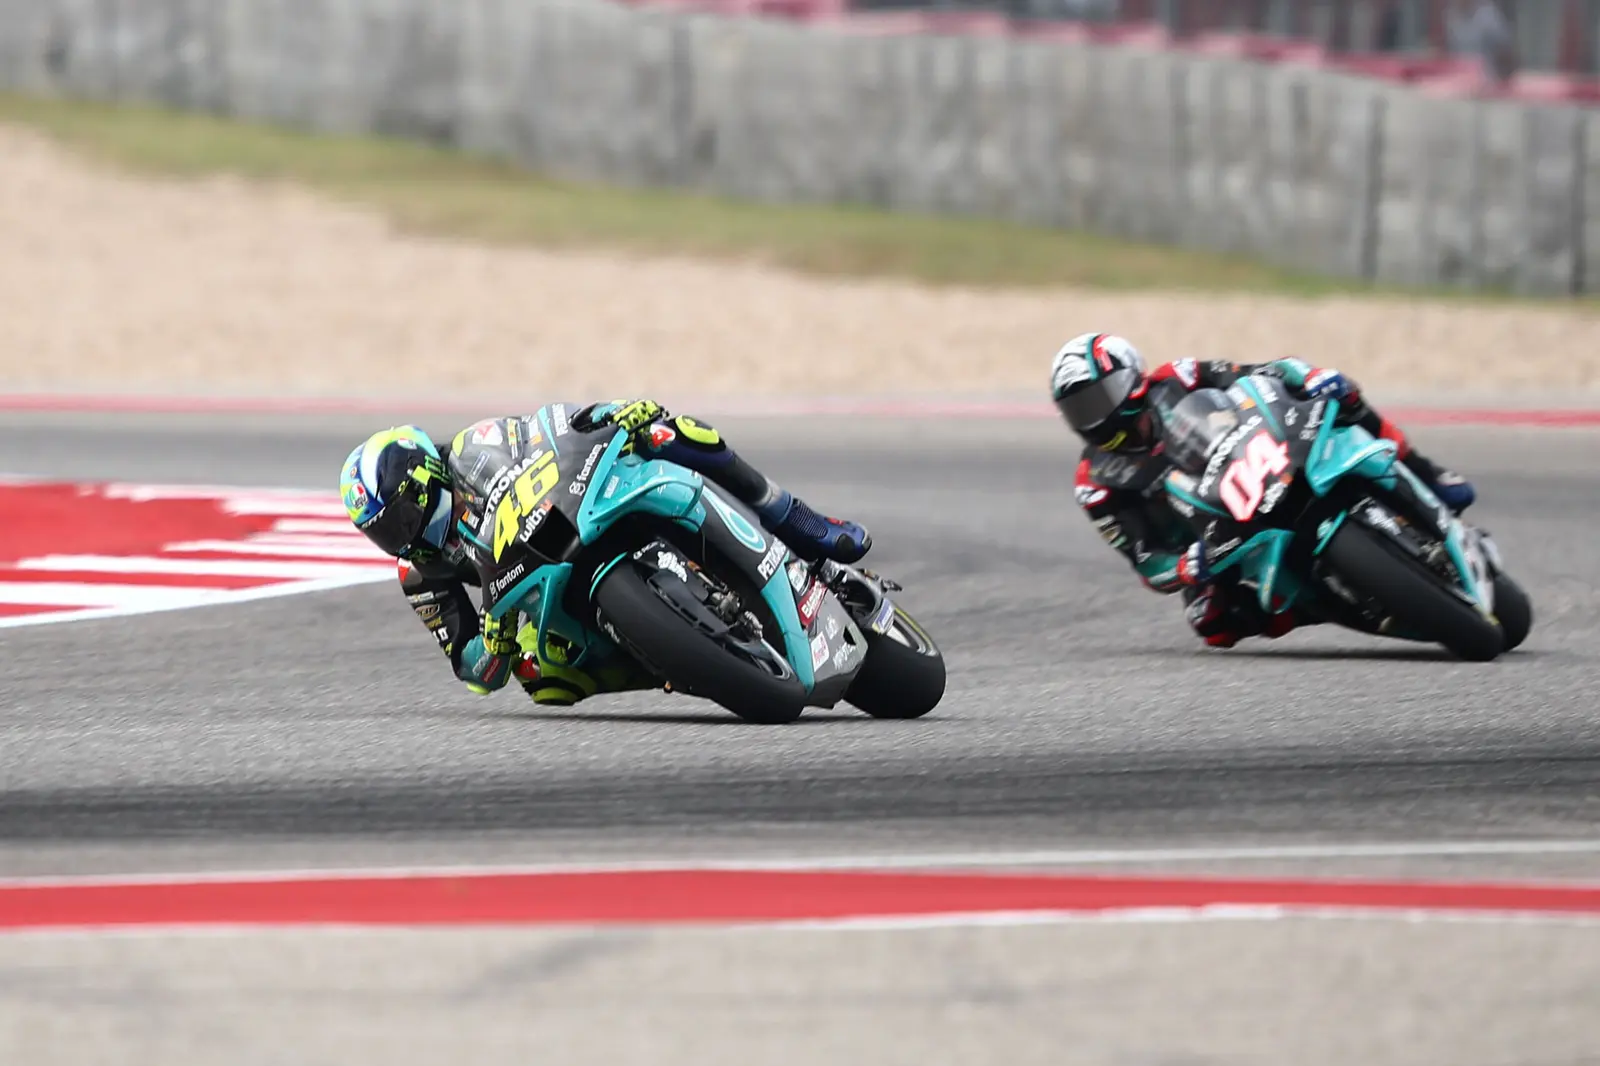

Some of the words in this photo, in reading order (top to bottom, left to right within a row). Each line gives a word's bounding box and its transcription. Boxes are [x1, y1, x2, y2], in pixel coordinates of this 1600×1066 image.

[493, 449, 560, 564] 46
[1219, 429, 1291, 523] 04
[495, 563, 525, 592] fantom
